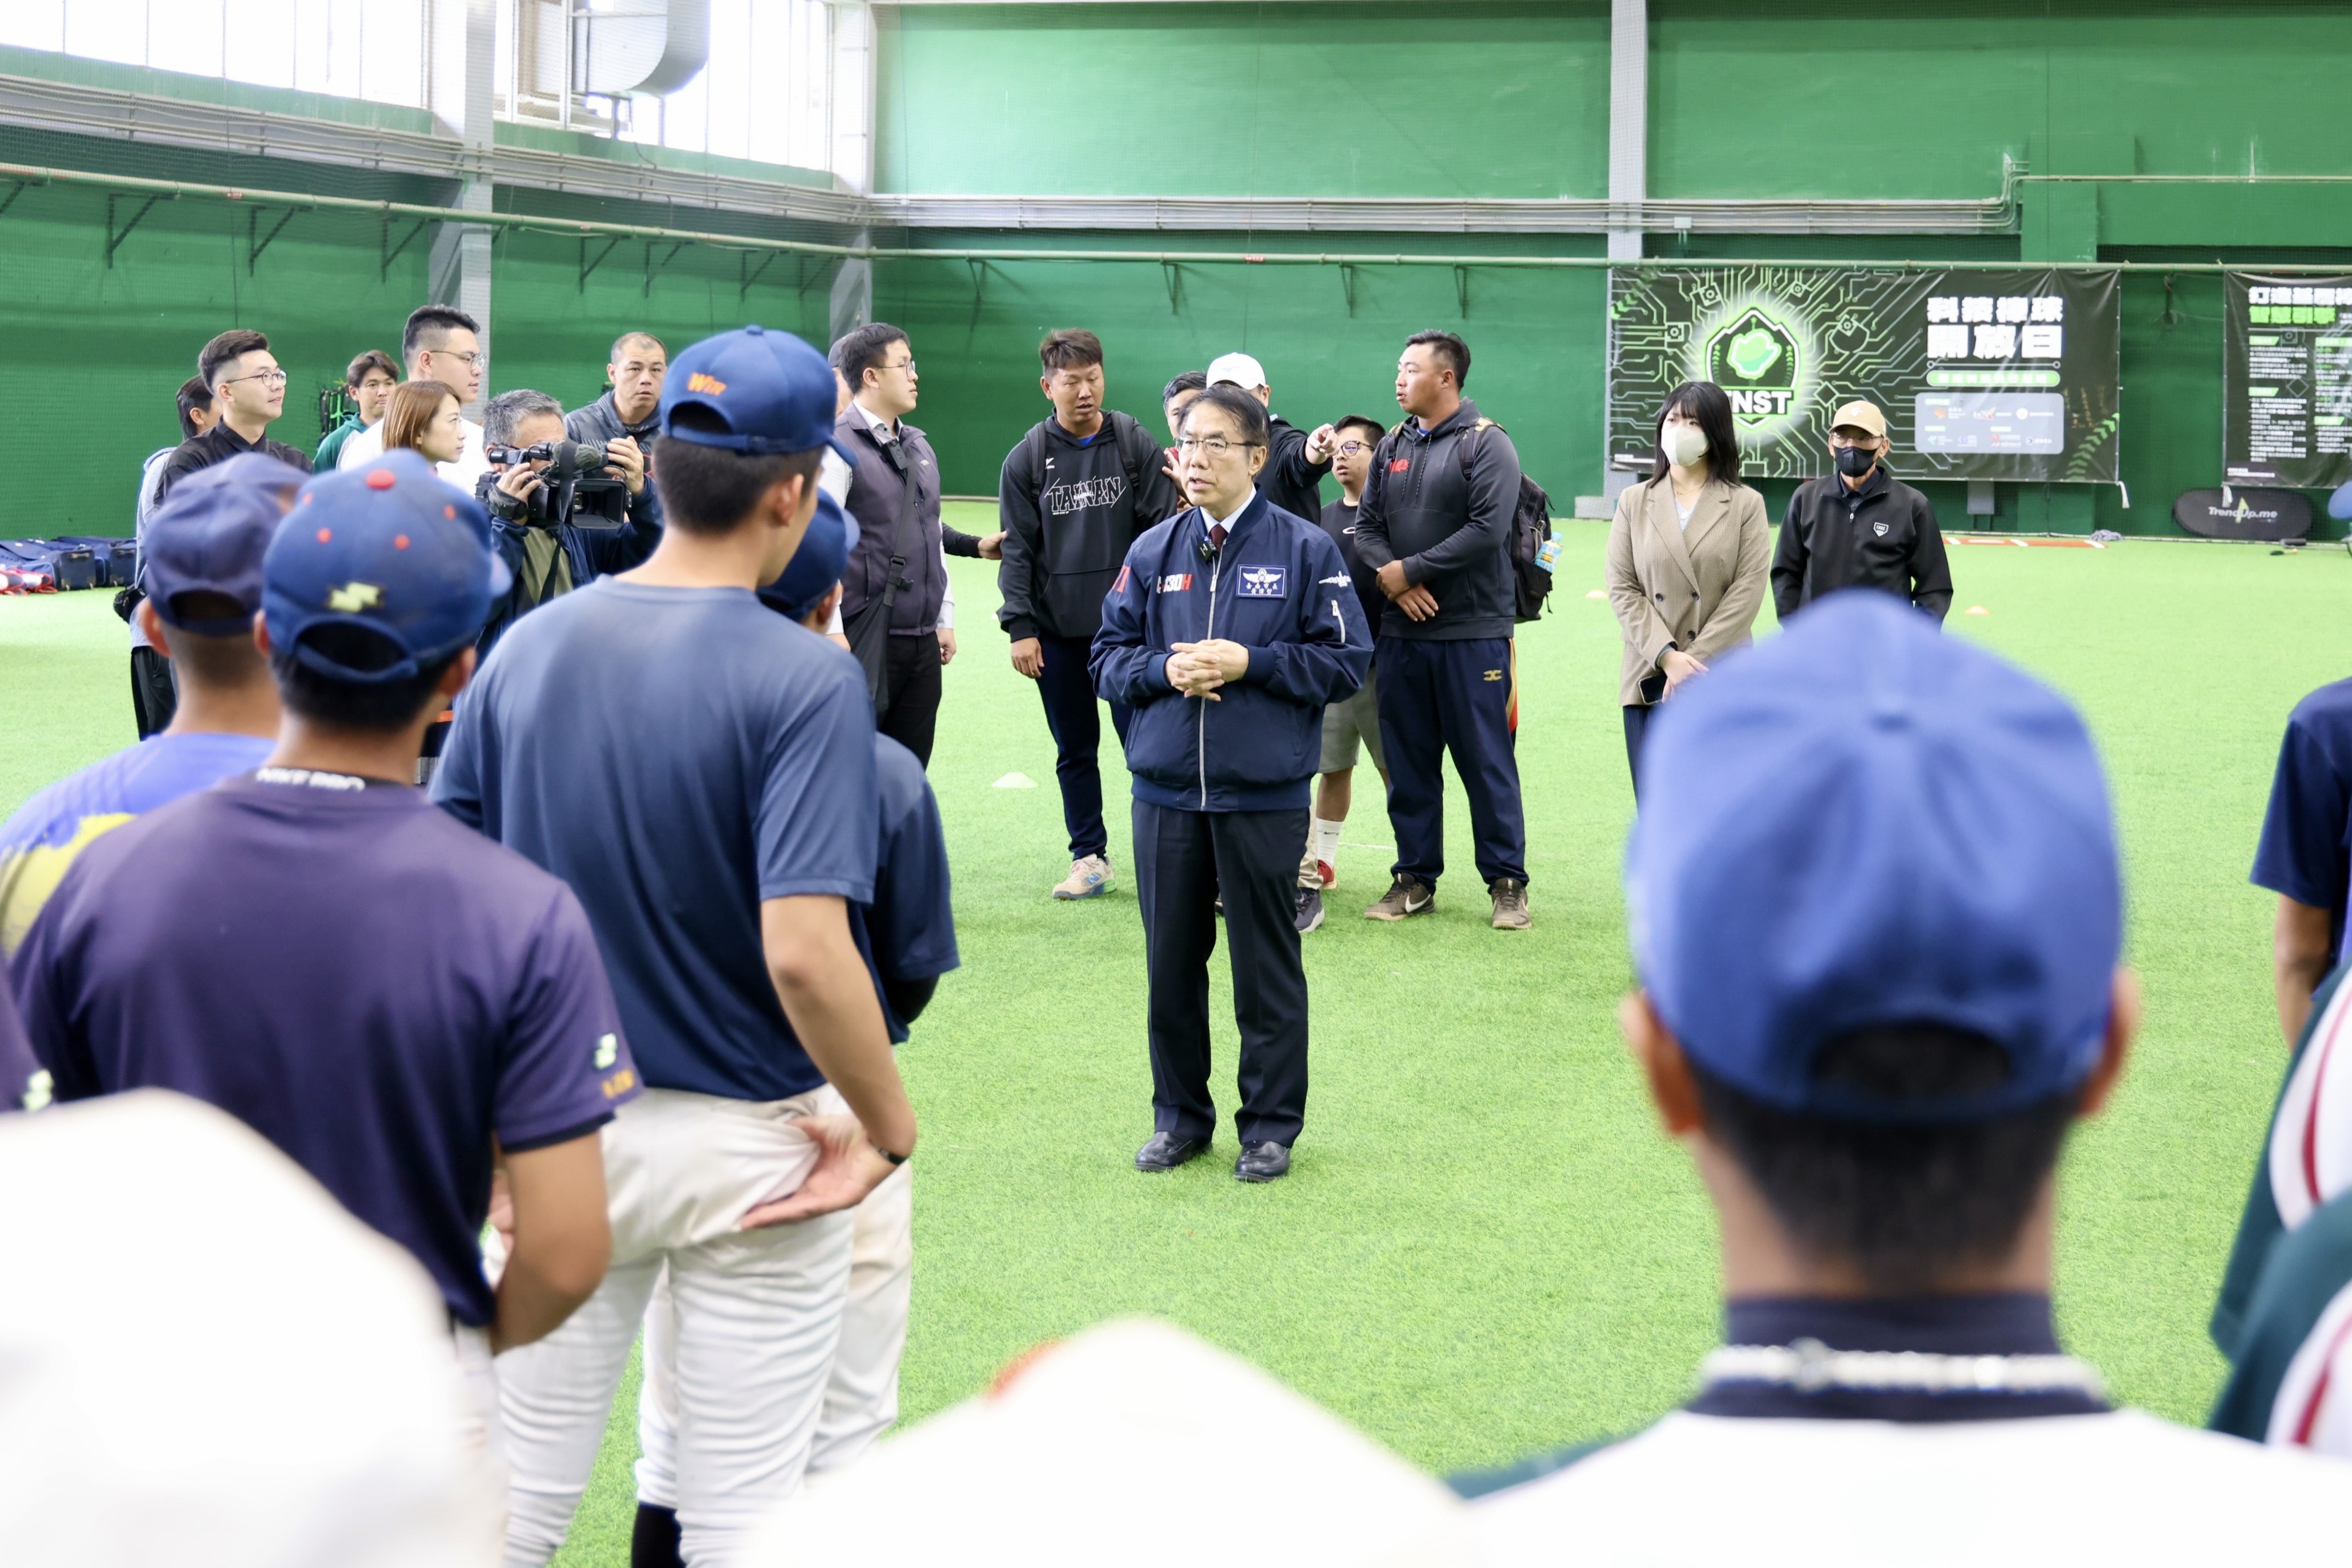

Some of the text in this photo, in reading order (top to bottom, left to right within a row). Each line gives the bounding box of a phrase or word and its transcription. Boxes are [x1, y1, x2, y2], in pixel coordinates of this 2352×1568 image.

[1926, 296, 2064, 323] 科技棒球
[1926, 324, 2063, 359] 開放日
[1726, 390, 1793, 414] NST
[1047, 476, 1121, 512] TAINAN
